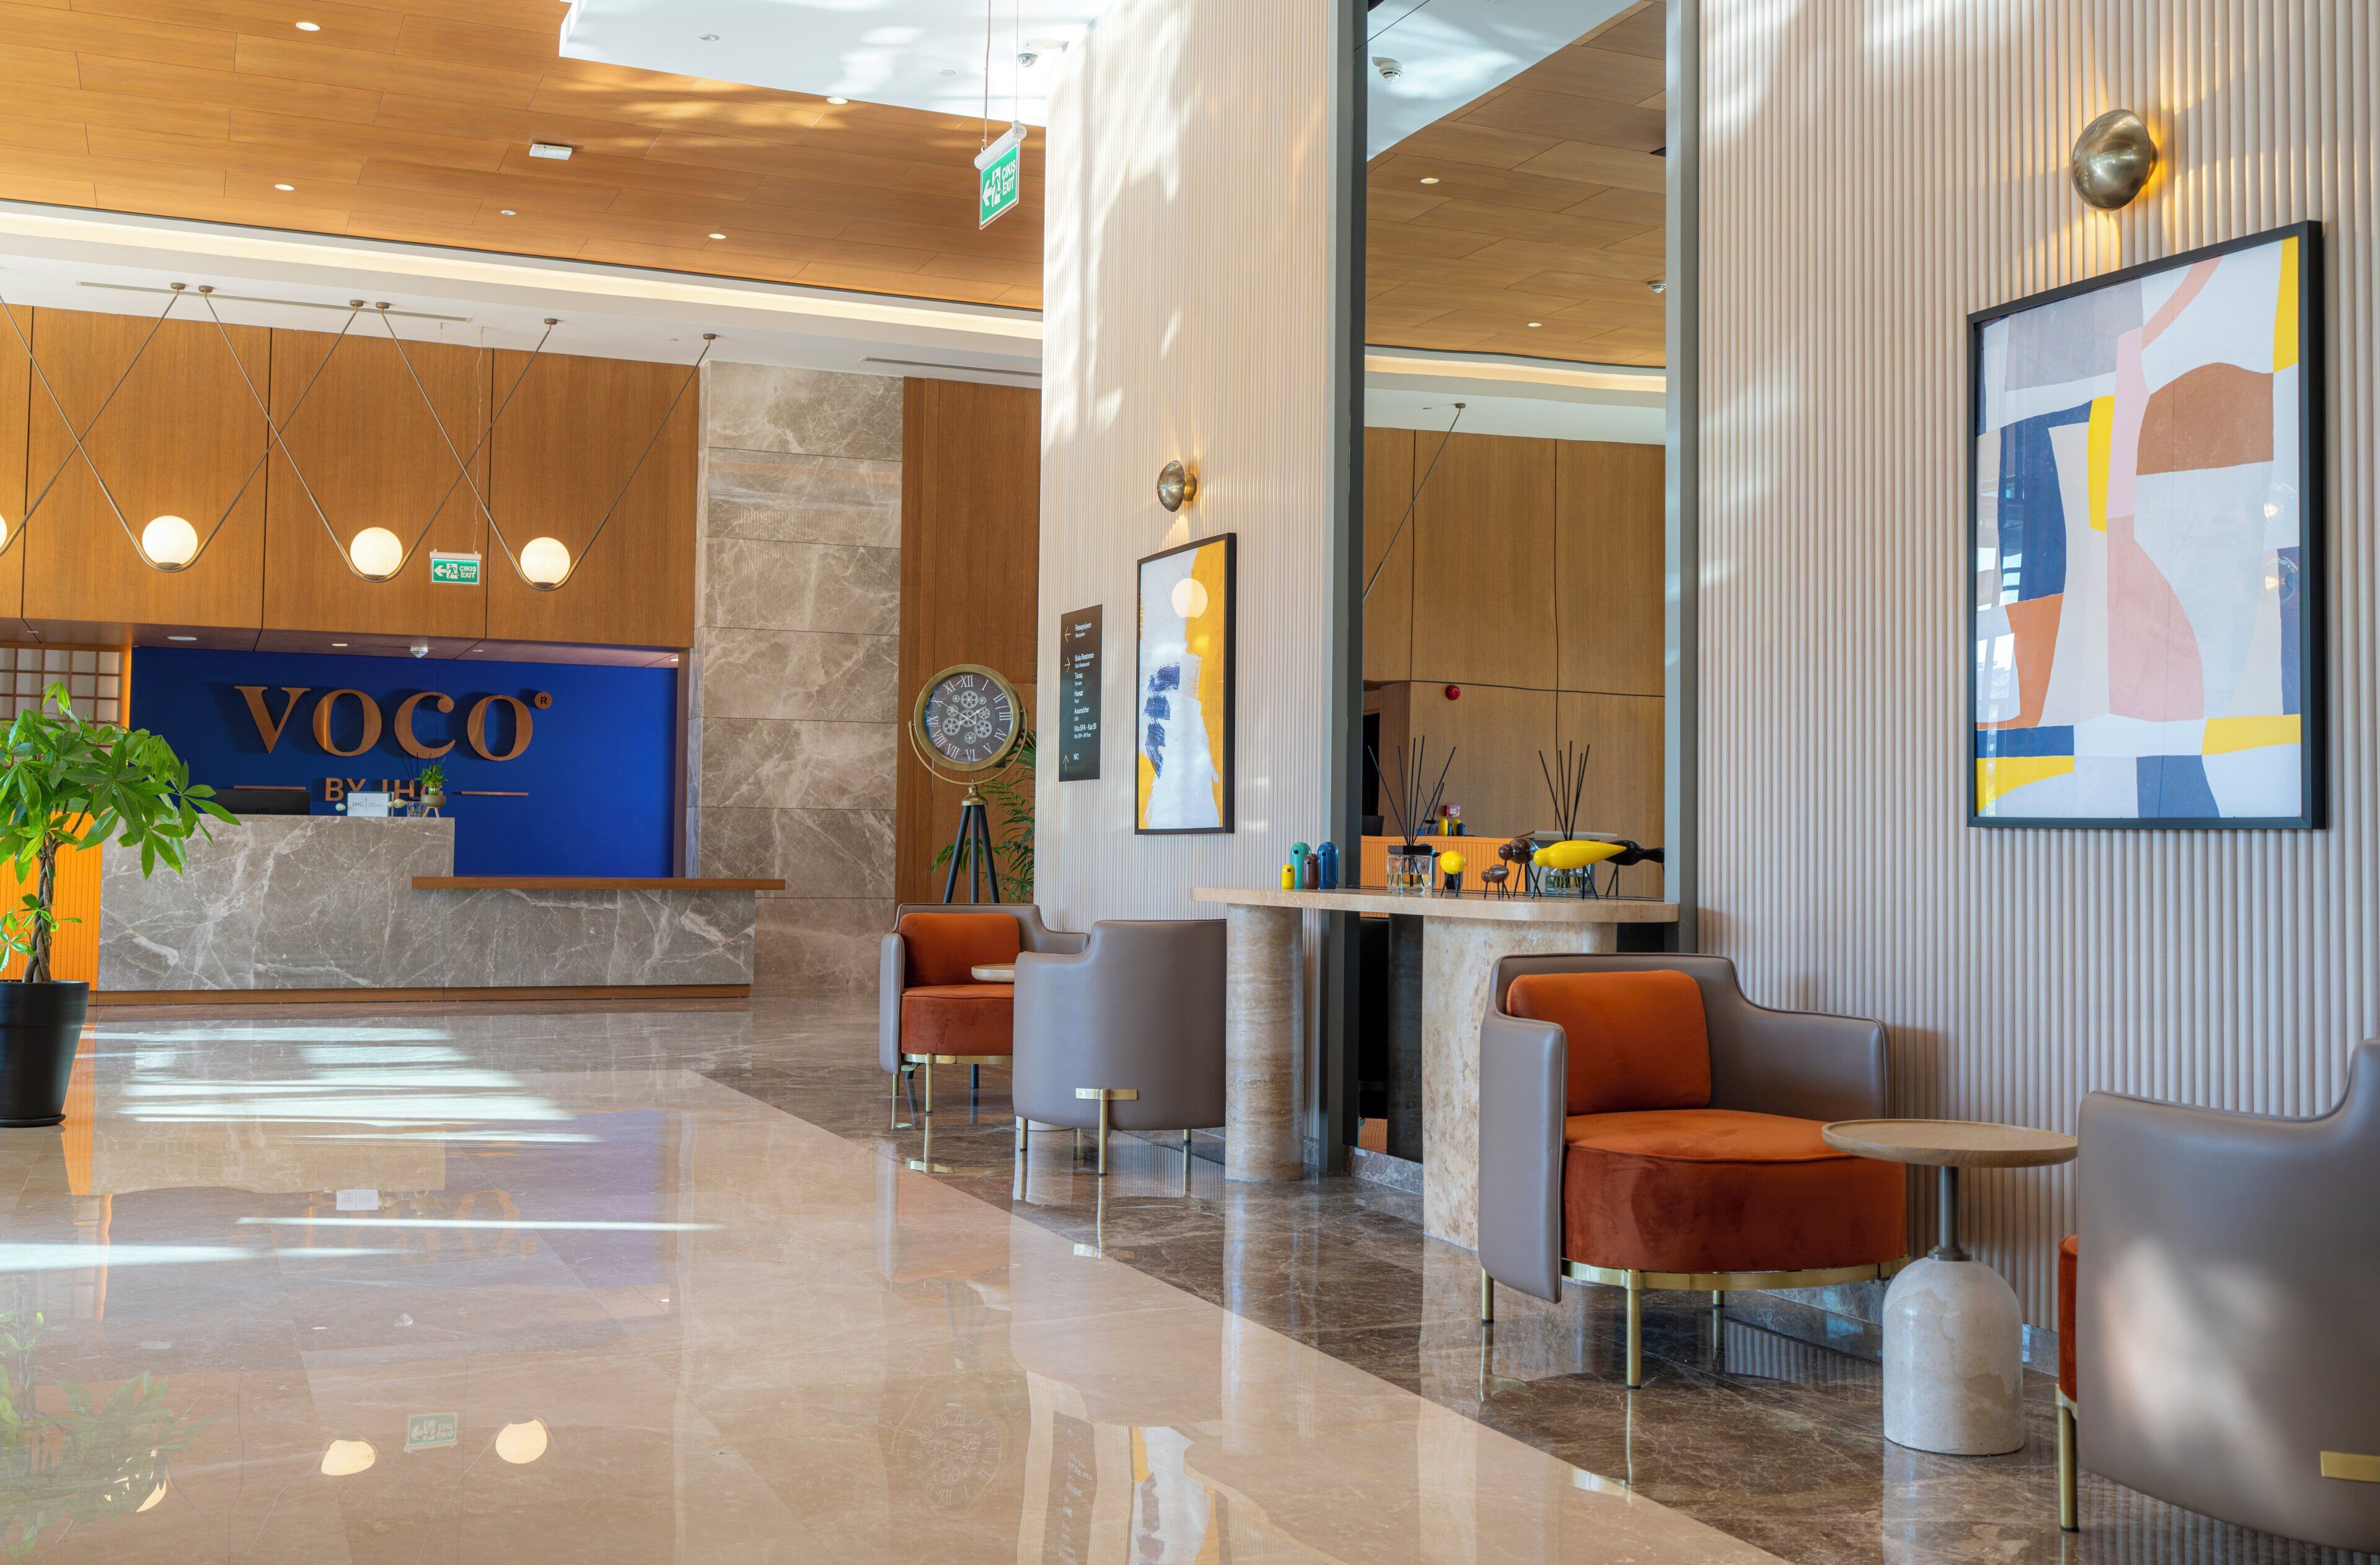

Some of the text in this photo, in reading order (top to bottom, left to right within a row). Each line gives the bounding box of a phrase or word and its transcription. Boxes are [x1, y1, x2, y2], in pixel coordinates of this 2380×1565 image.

[1003, 177, 1014, 196] EXIT
[1075, 622, 1091, 631] Resepsiyon
[325, 778, 366, 801] BY
